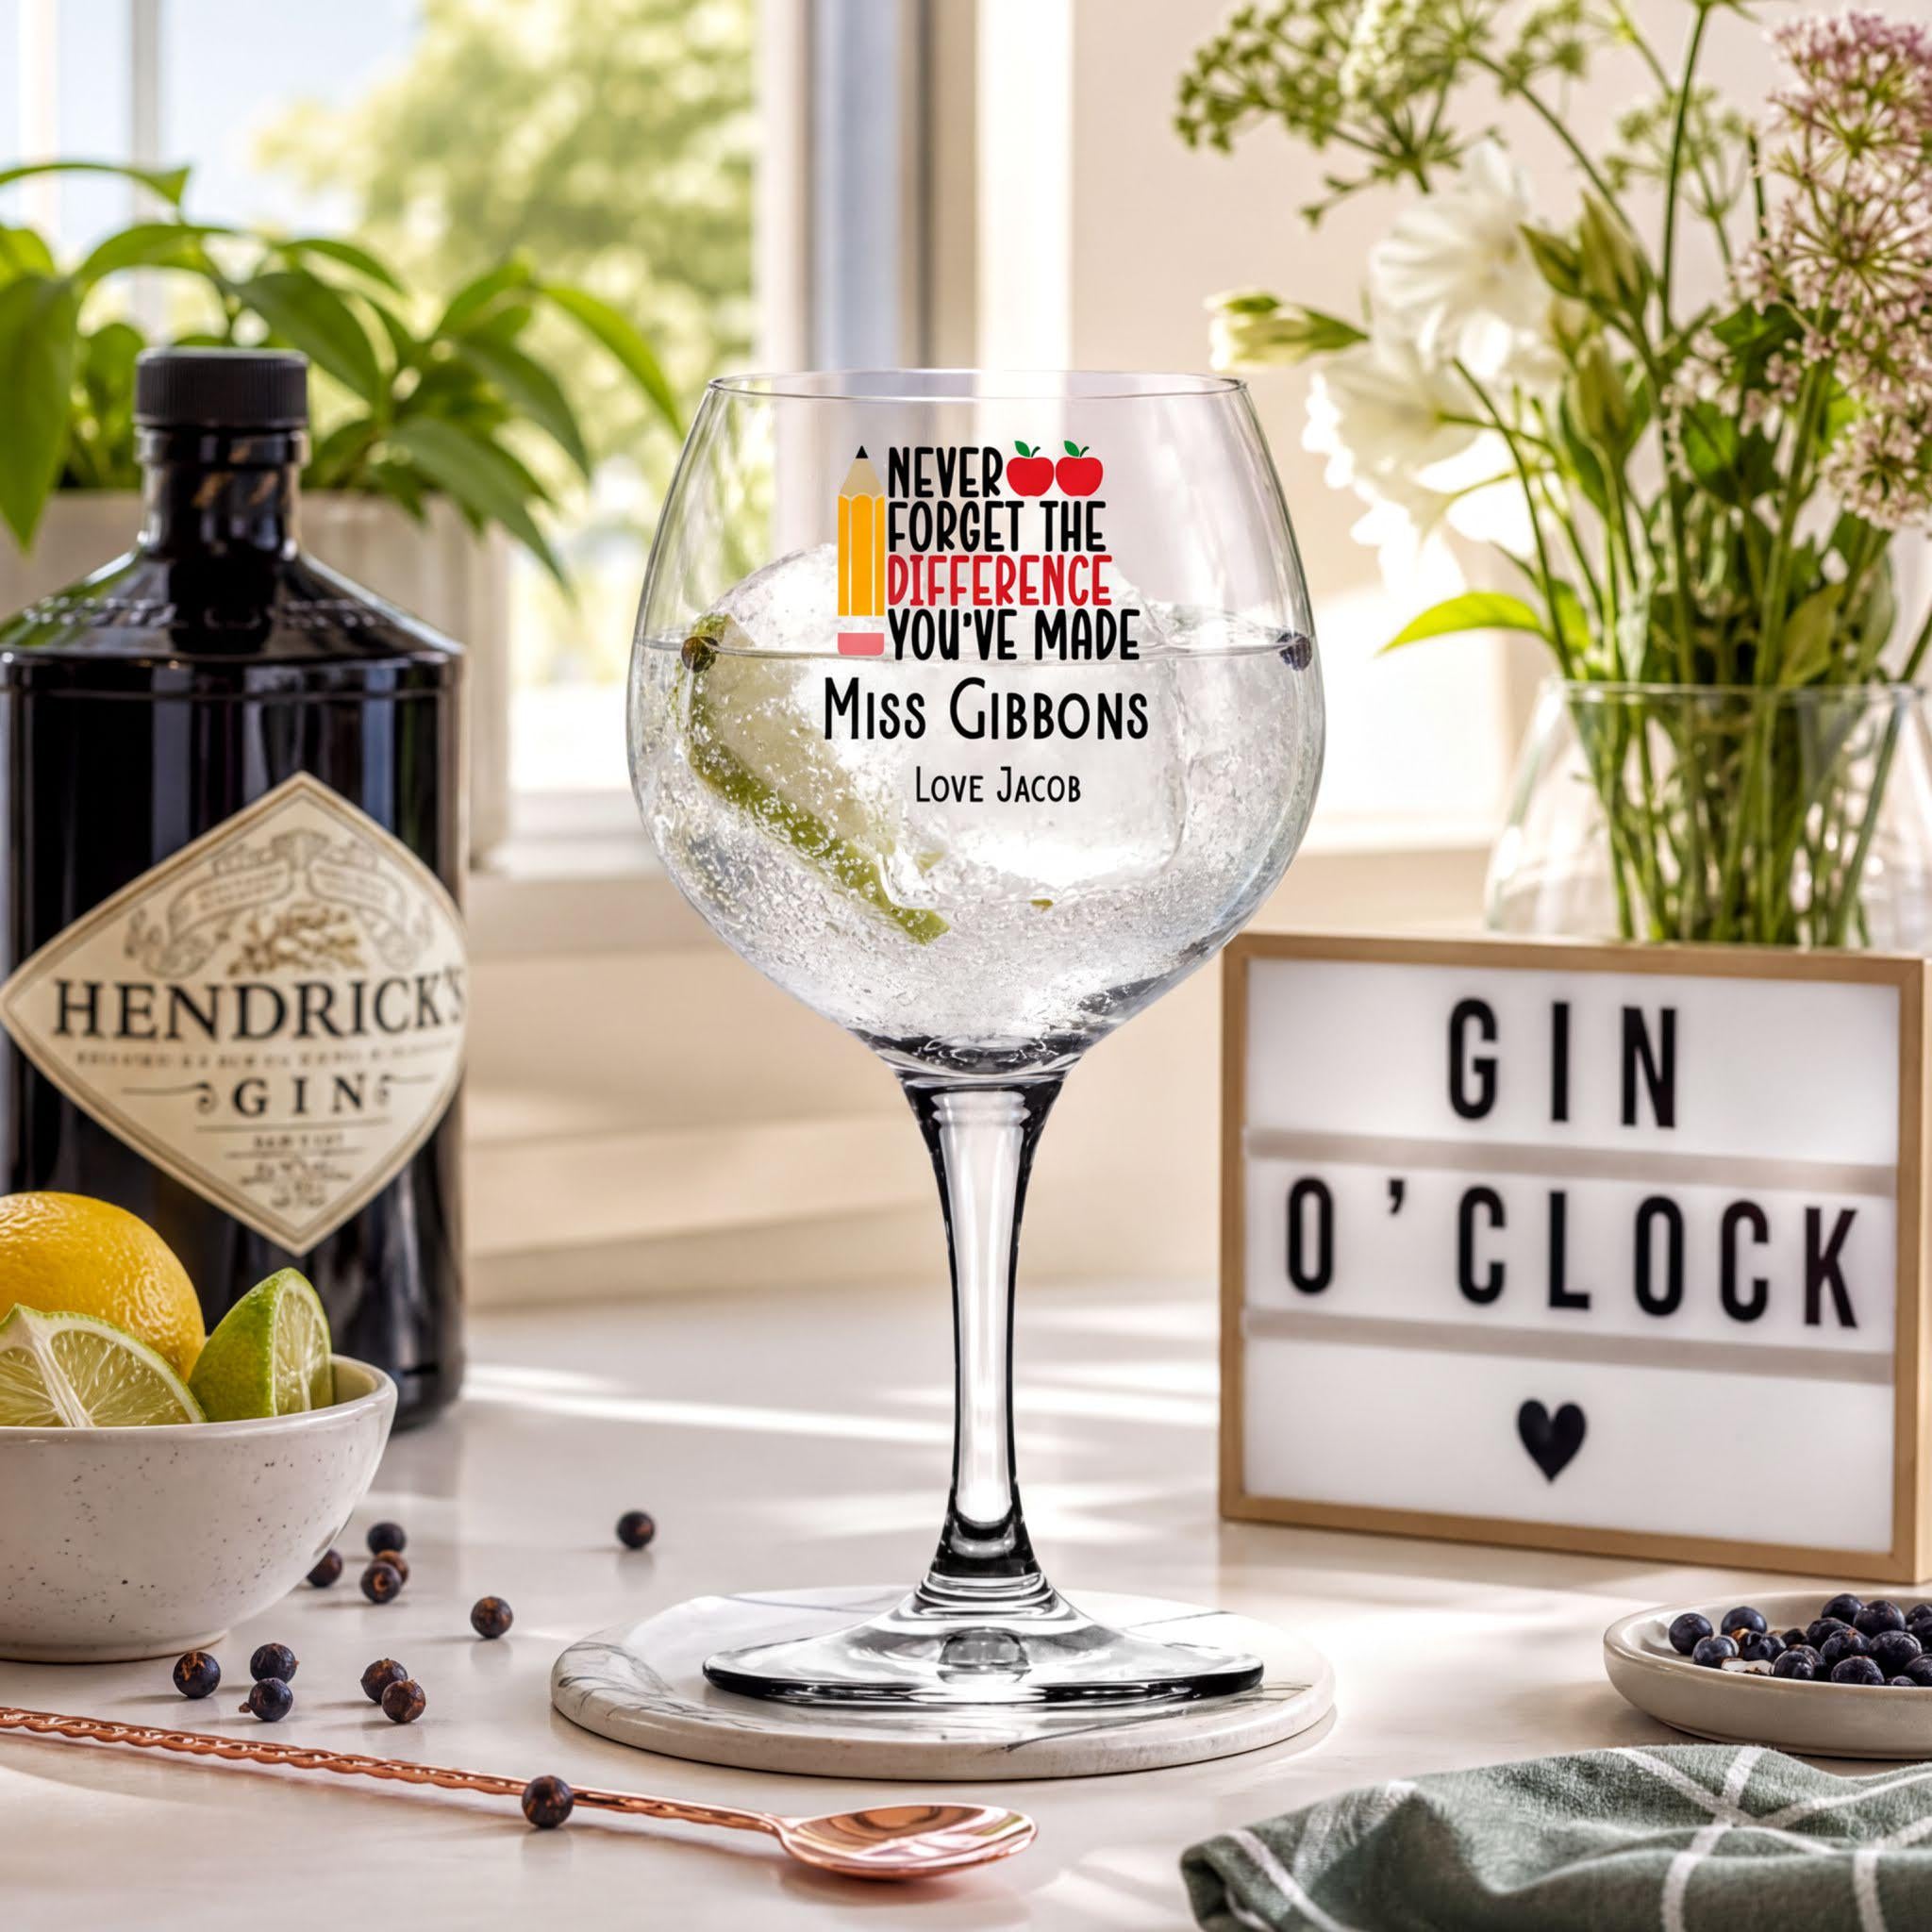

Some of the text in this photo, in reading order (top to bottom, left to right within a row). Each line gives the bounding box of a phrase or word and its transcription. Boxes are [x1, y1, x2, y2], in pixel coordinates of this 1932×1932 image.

[888, 447, 1003, 498] NEVER
[888, 501, 1107, 552] FORGET THE
[888, 555, 1112, 606] DIFFERENCE
[888, 608, 1141, 660] YOU'VE MADE
[1448, 997, 1677, 1128] GIN
[232, 1073, 365, 1117] GIN
[1286, 1175, 1859, 1329] O'CLOCK
